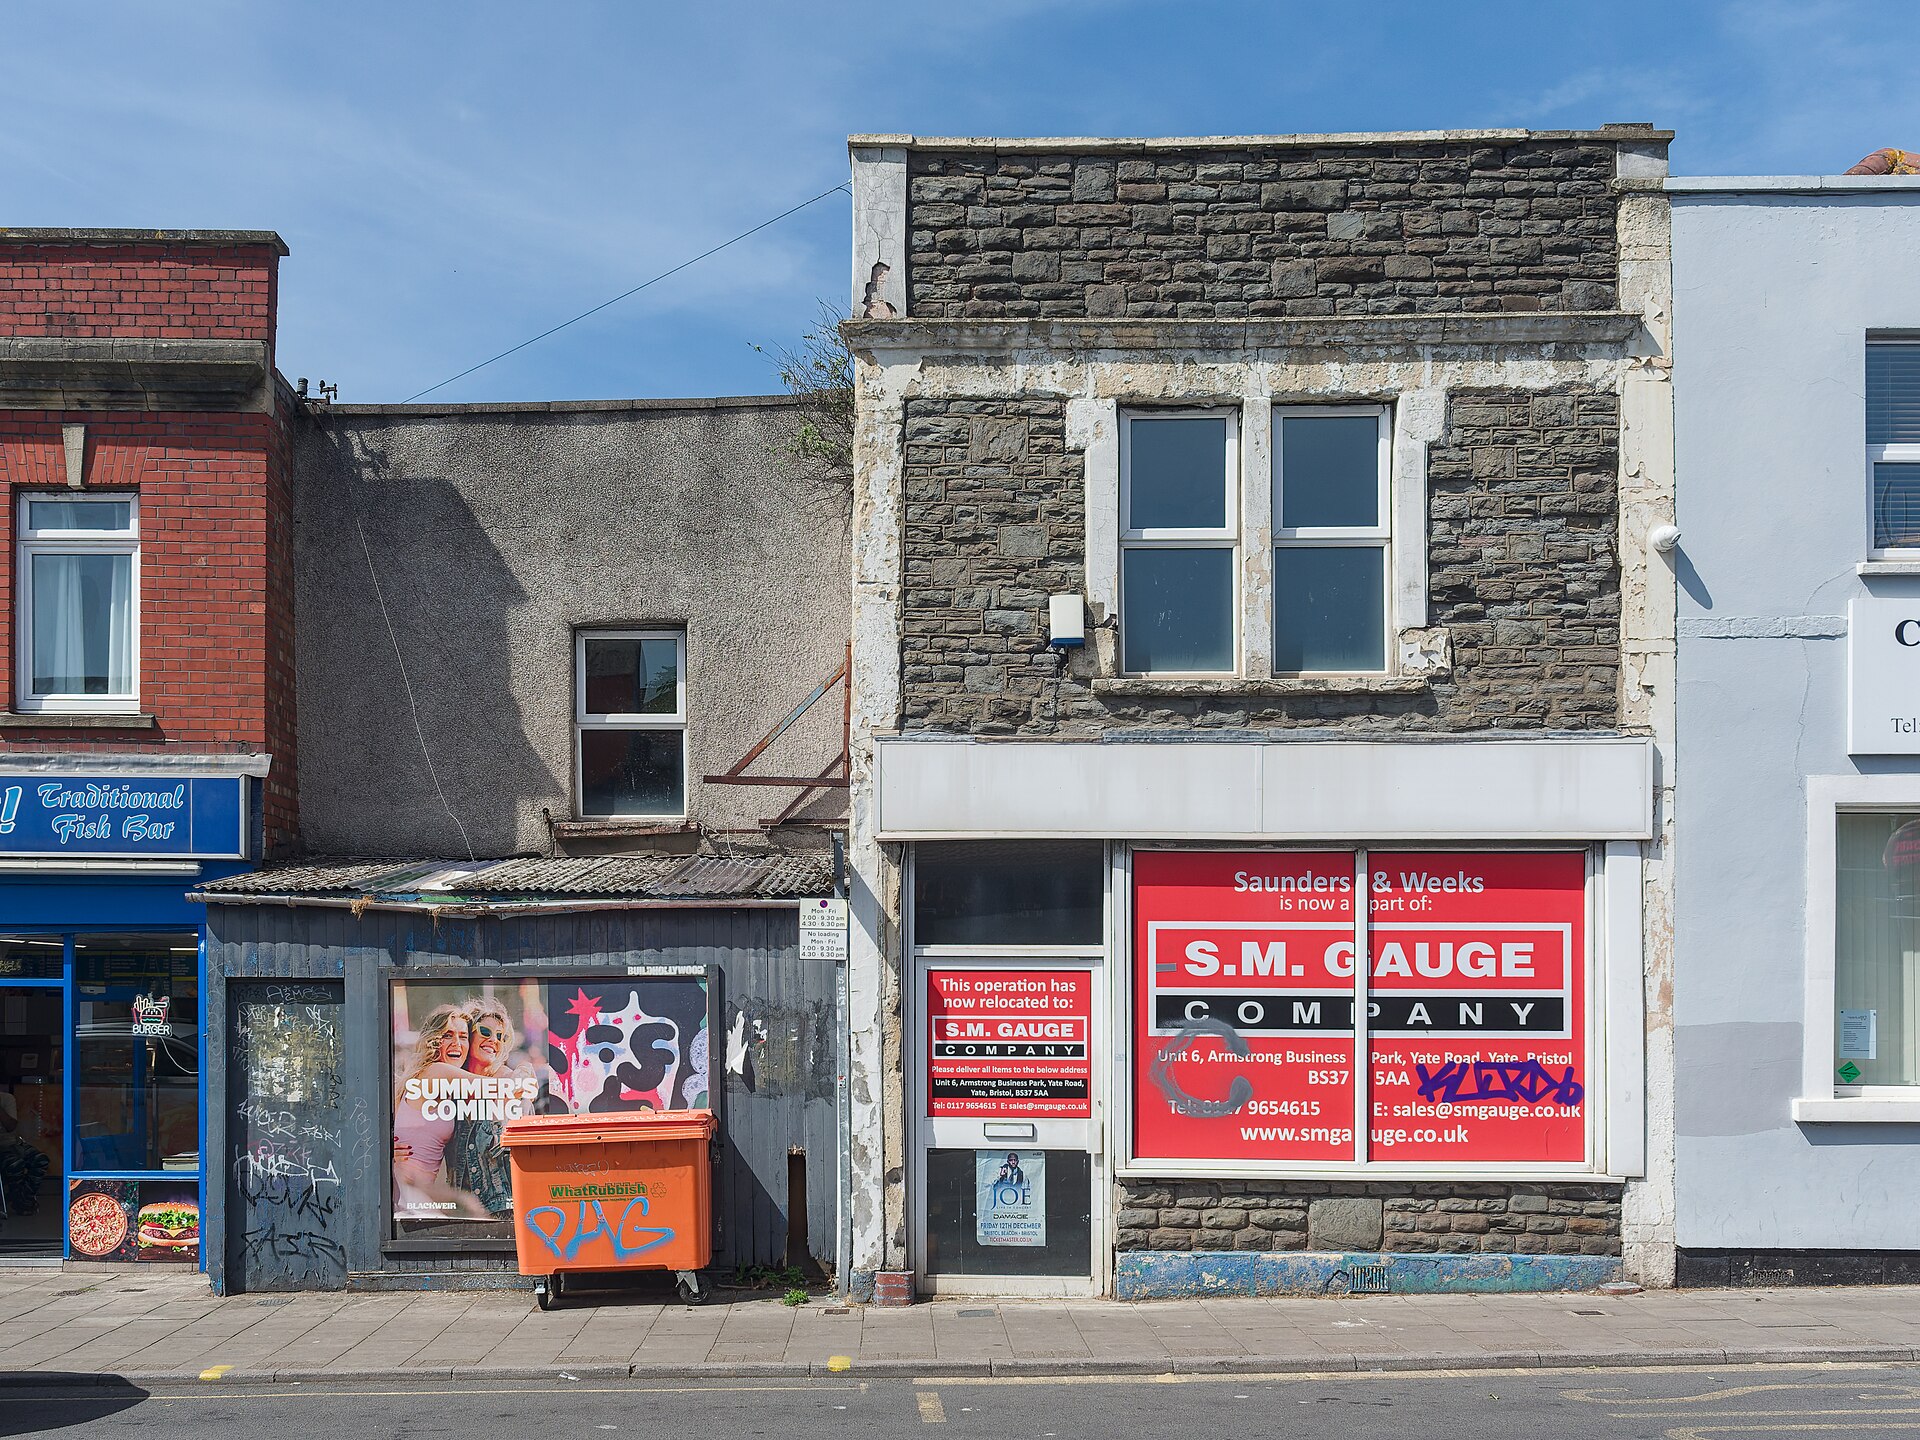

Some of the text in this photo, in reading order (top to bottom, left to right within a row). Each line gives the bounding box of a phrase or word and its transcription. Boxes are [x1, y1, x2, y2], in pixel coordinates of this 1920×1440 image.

[38, 783, 184, 809] Traditional
[52, 814, 175, 844] Fish Bar
[1234, 871, 1484, 893] Saunders & Weeks
[1280, 895, 1433, 914] is now a part of:
[1184, 940, 1535, 978] S.M. GAUGE
[627, 965, 704, 976] BUILDHOLLYWOOD
[940, 978, 1076, 994] This operation has
[943, 995, 1073, 1008] now relocated to:
[132, 1025, 170, 1035] BURGER
[945, 1022, 1074, 1037] S.M. GAUGE
[945, 1046, 1074, 1055] COMPANY
[1157, 1050, 1188, 1063] Unit
[1191, 1050, 1204, 1064] 6,
[1208, 1050, 1283, 1065] Armstrong
[1286, 1050, 1347, 1063] Business
[1371, 1051, 1407, 1066] Park,
[1410, 1052, 1440, 1064] Yate
[1526, 1051, 1573, 1064] Bristol
[952, 1079, 959, 1087] 6,
[960, 1079, 996, 1088] Armstrong
[997, 1079, 1028, 1087] Business
[1064, 1080, 1085, 1088] Road,
[1308, 1070, 1411, 1086] BS37 5AA
[404, 1078, 539, 1101] SUMMER'S
[970, 1089, 1049, 1097] Yate, Bristol, BS37 5AA
[421, 1099, 523, 1121] COMING
[1009, 1102, 1087, 1111] sales@smgauge.co.uk
[1248, 1100, 1321, 1115] 9654615
[1373, 1102, 1389, 1117] E:
[1393, 1102, 1581, 1120] sales@smgauge.co.uk
[1240, 1124, 1469, 1146] www.smgauge.co.uk
[550, 1183, 648, 1197] WhatRubbish
[406, 1202, 457, 1210] BLACKWEIR
[991, 1188, 1031, 1210] JOE
